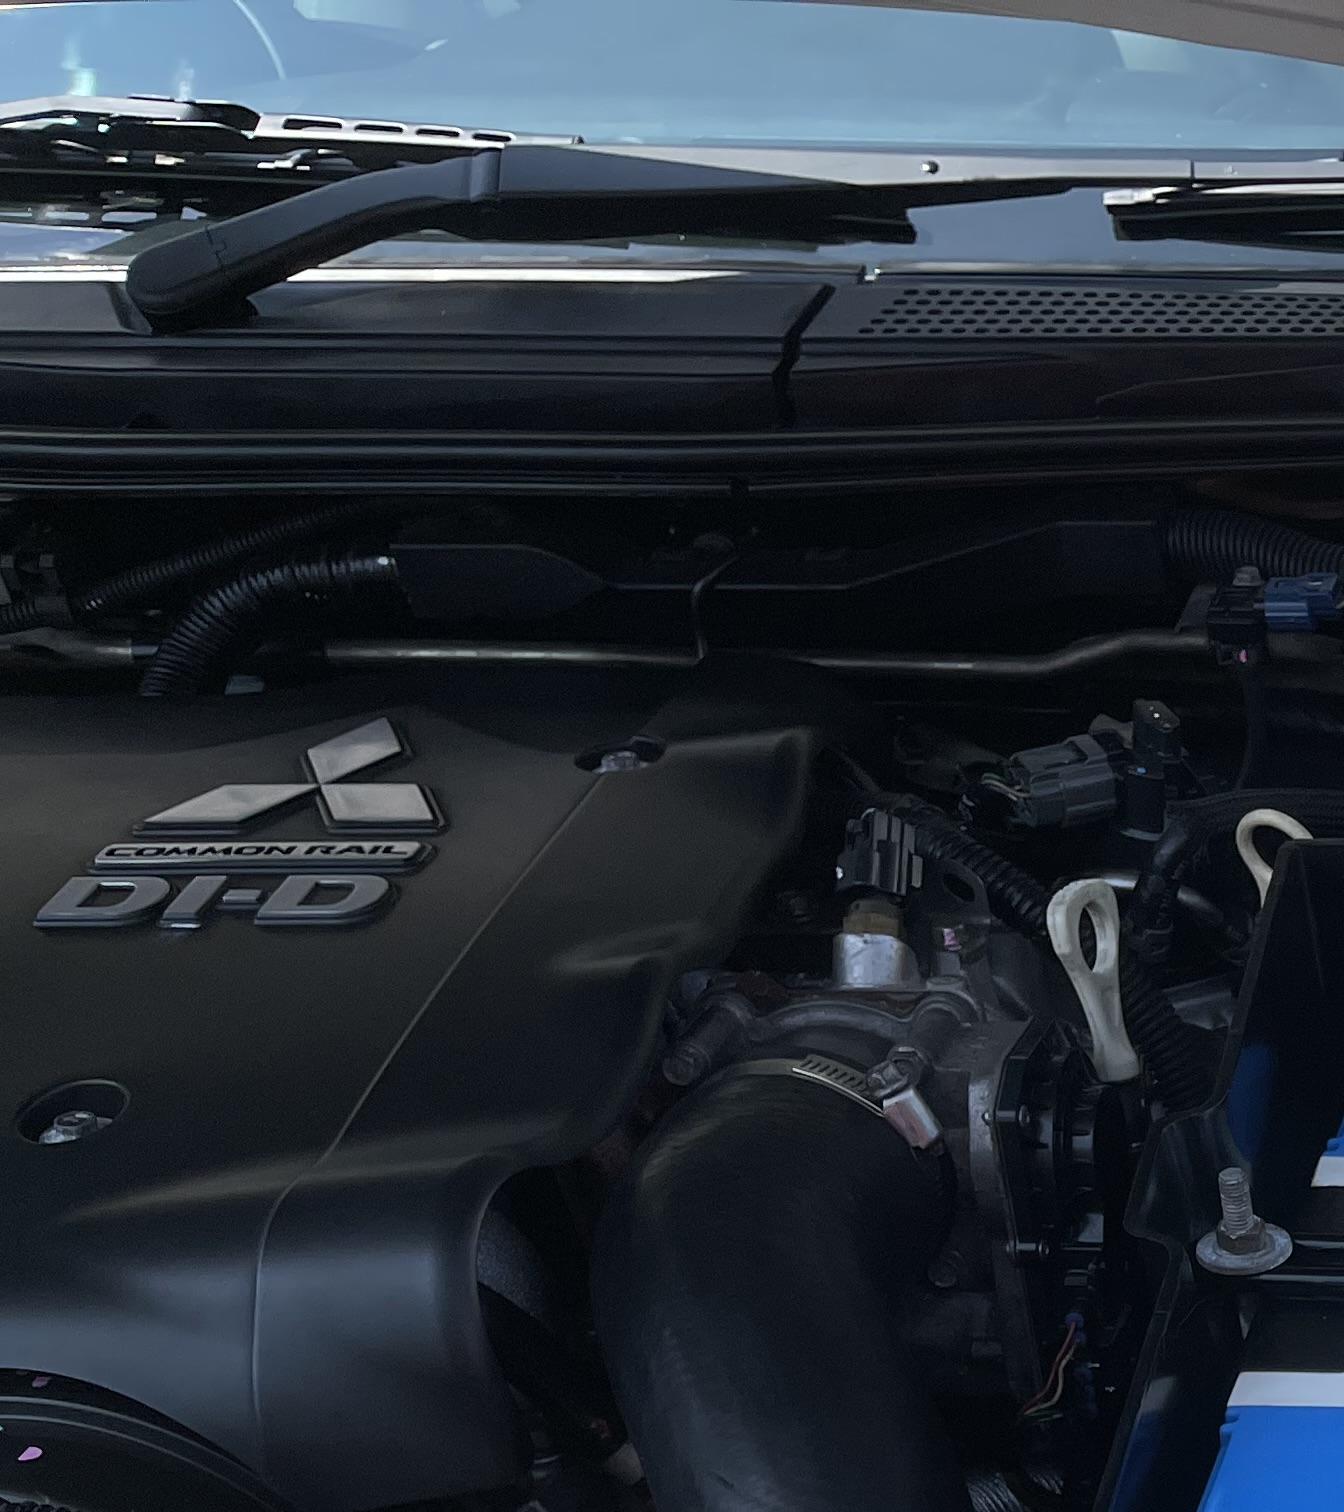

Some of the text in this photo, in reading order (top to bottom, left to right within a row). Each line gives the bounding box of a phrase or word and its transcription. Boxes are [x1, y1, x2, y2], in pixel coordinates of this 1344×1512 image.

[104, 844, 409, 858] COMMON RAIL
[33, 875, 392, 928] DI-D
